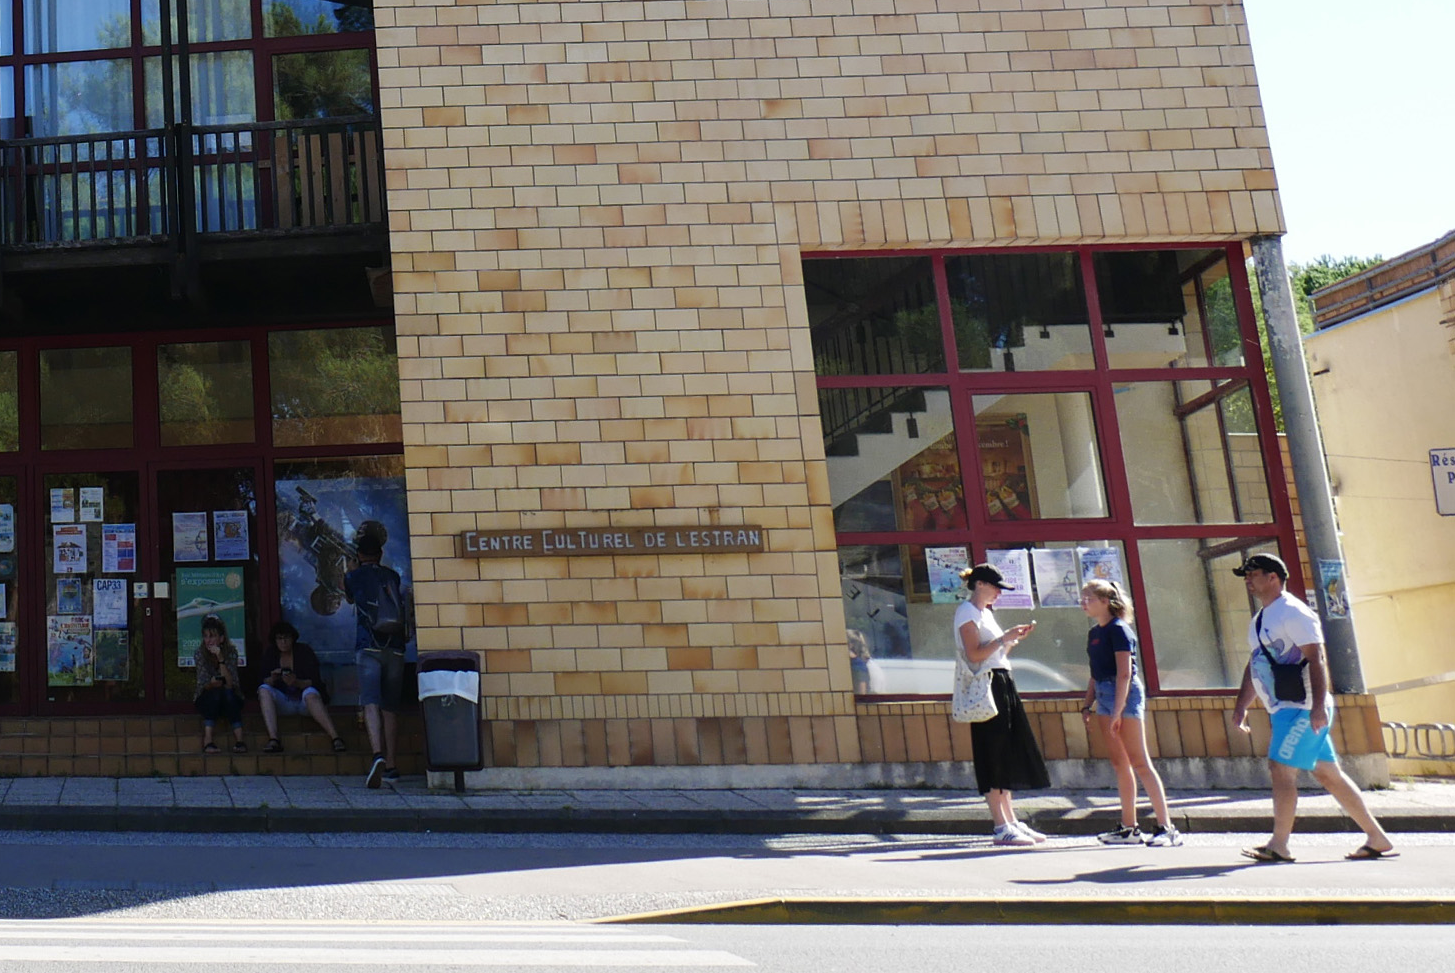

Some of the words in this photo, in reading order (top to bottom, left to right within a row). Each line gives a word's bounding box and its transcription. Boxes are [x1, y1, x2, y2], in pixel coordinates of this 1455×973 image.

[465, 531, 533, 552] CENTRE
[542, 529, 634, 554] CULTUREL
[644, 531, 666, 548] DE
[676, 529, 760, 548] L'ESTRAN
[96, 580, 121, 591] CAP33
[1278, 716, 1310, 760] arena
